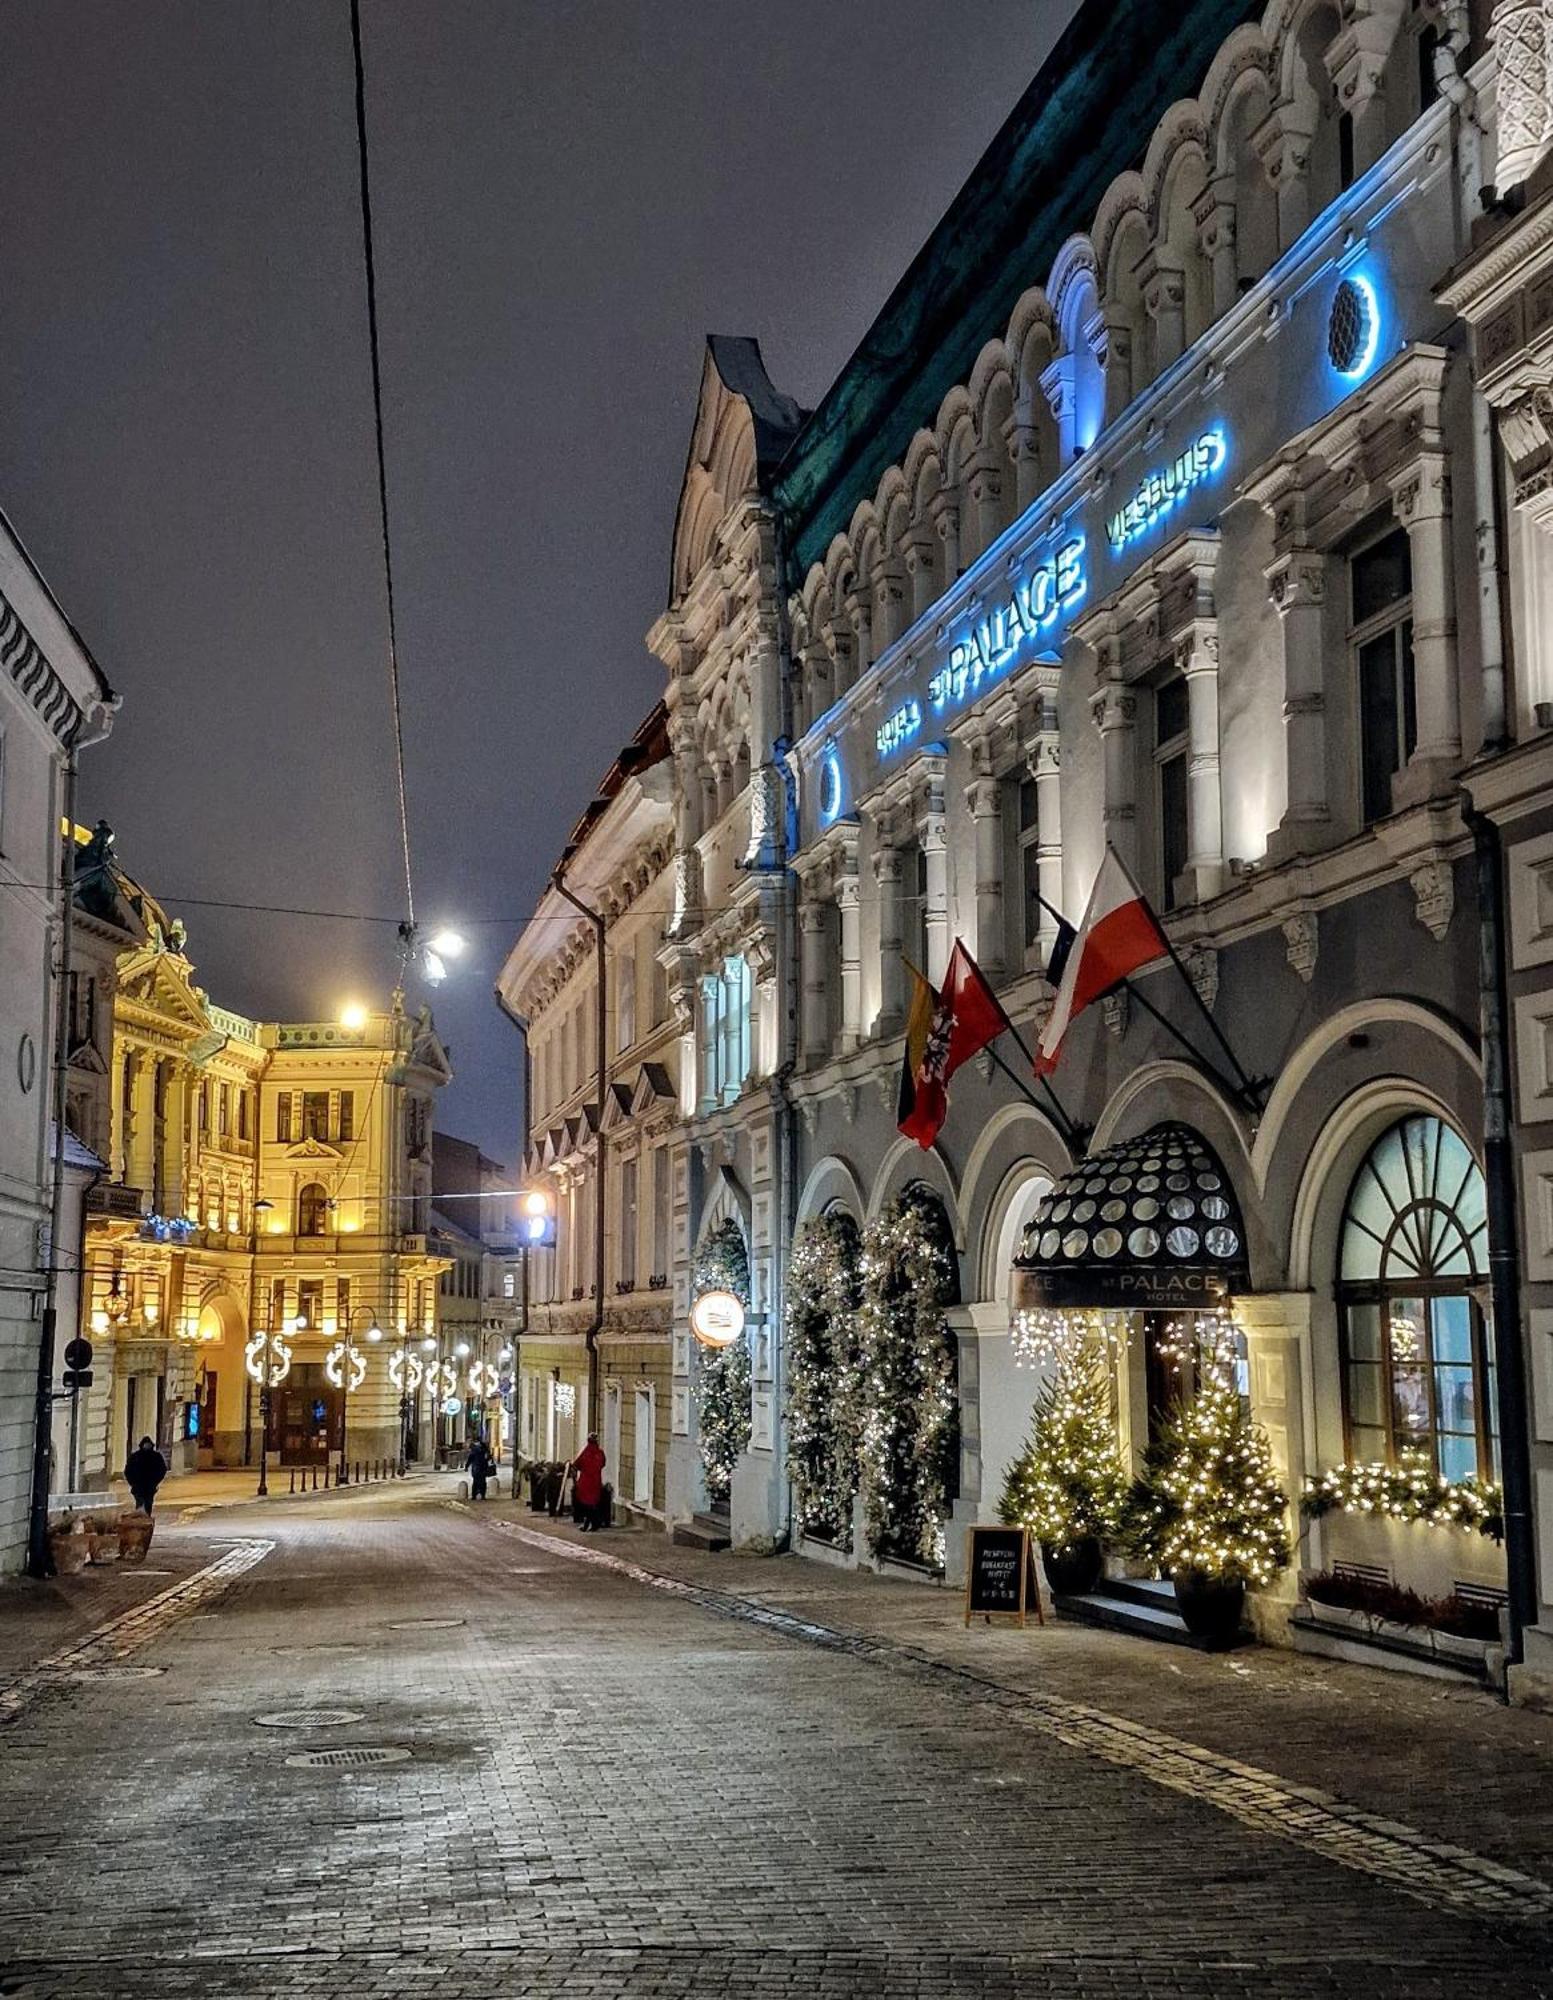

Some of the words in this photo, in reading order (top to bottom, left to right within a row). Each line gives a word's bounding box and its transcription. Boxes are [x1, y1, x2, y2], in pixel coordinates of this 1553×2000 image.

[949, 537, 1086, 697] PALACE
[1120, 1274, 1218, 1291] PALACE
[1147, 1292, 1185, 1301] HOTEL
